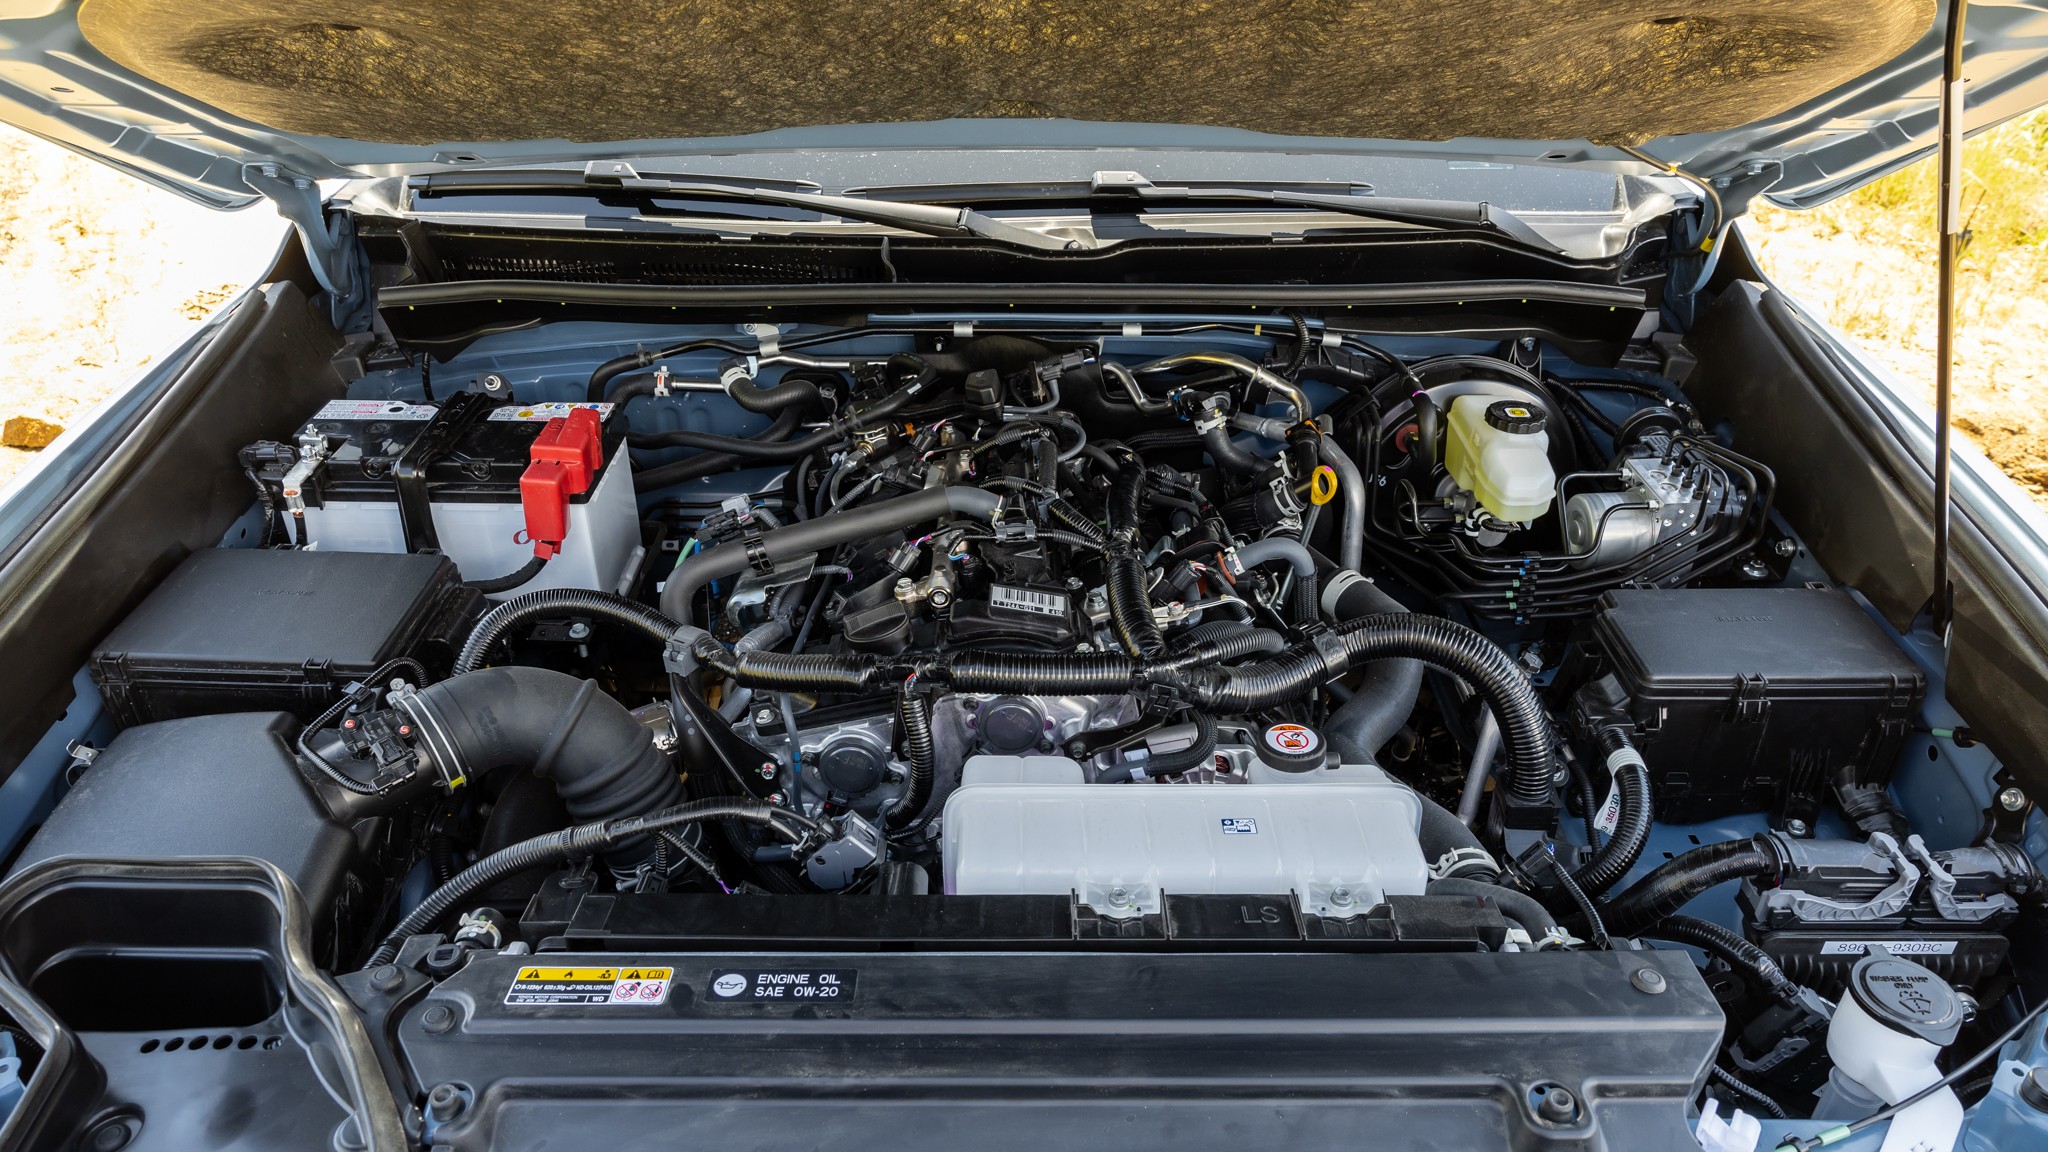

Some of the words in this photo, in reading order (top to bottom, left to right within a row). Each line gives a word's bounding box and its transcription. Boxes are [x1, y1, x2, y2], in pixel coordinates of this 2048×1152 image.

[1241, 905, 1280, 923] LS
[1837, 943, 1942, 953] 896-930BC
[757, 974, 810, 984] ENGINE
[819, 974, 841, 984] OIL
[754, 986, 785, 997] SAE
[793, 986, 839, 997] 0W-20
